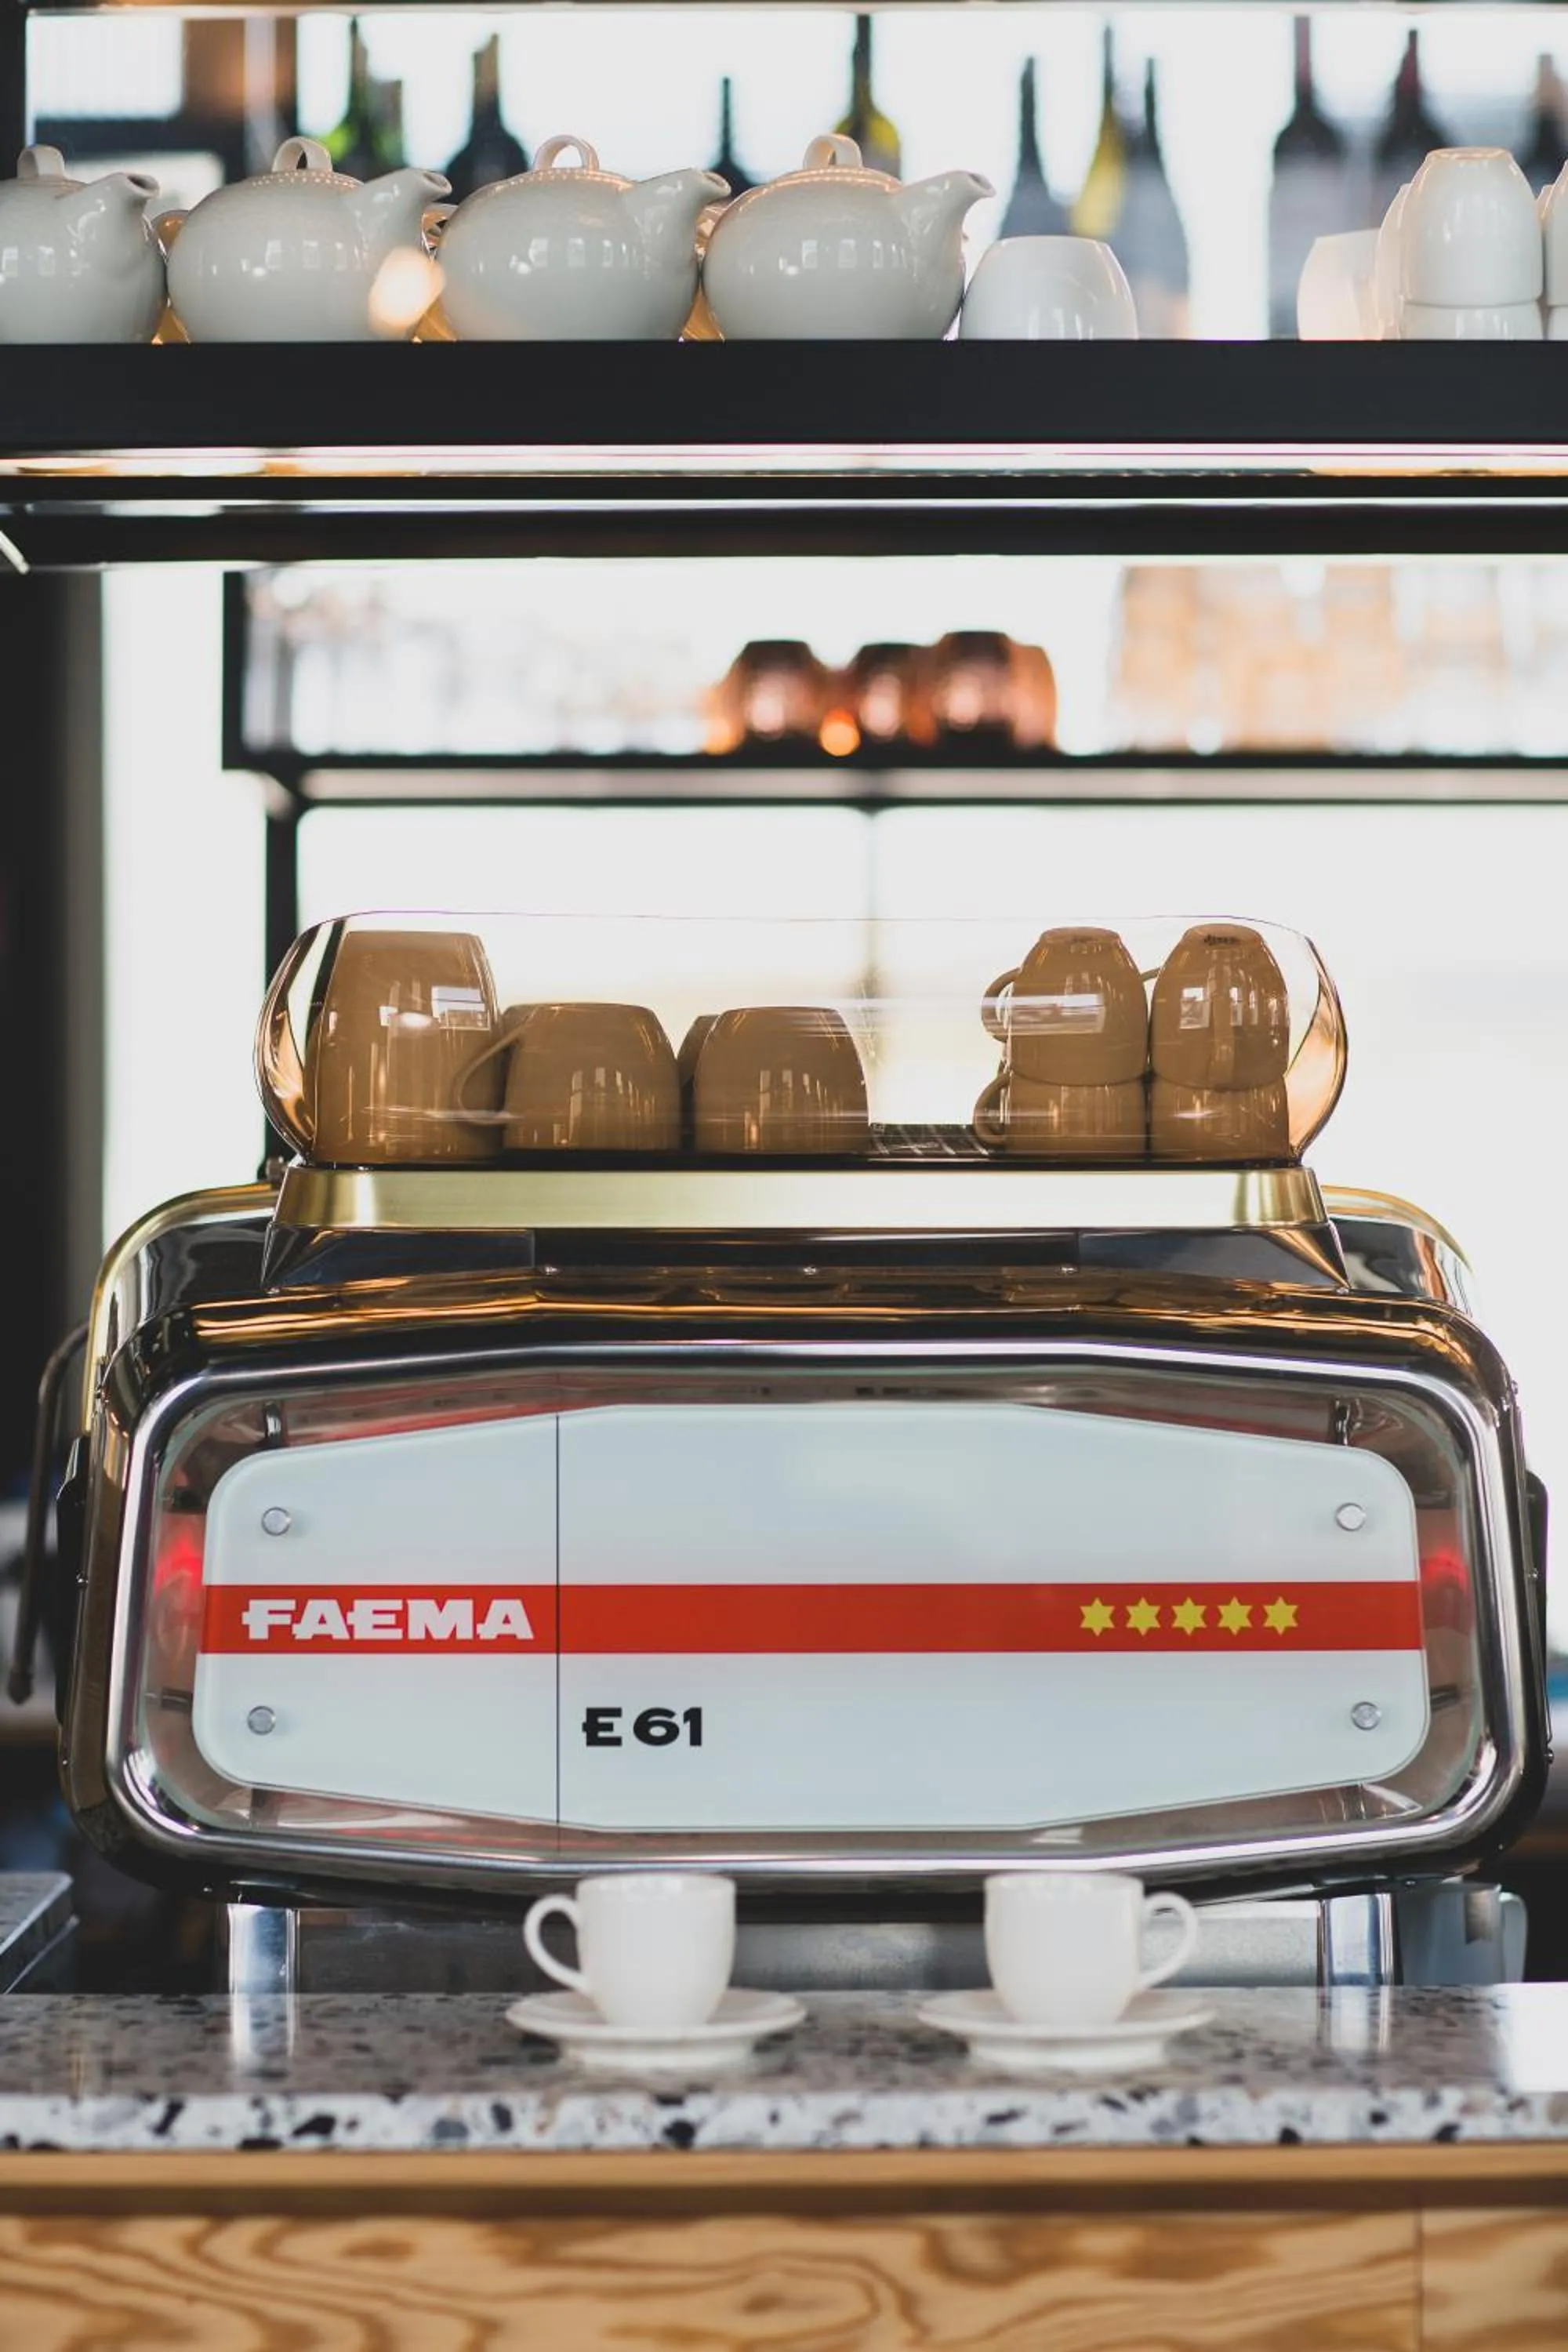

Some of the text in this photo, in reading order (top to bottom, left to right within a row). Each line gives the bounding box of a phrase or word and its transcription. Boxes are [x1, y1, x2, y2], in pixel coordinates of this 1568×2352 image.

[241, 1599, 534, 1640] FAEMA
[582, 1707, 702, 1747] E 61
